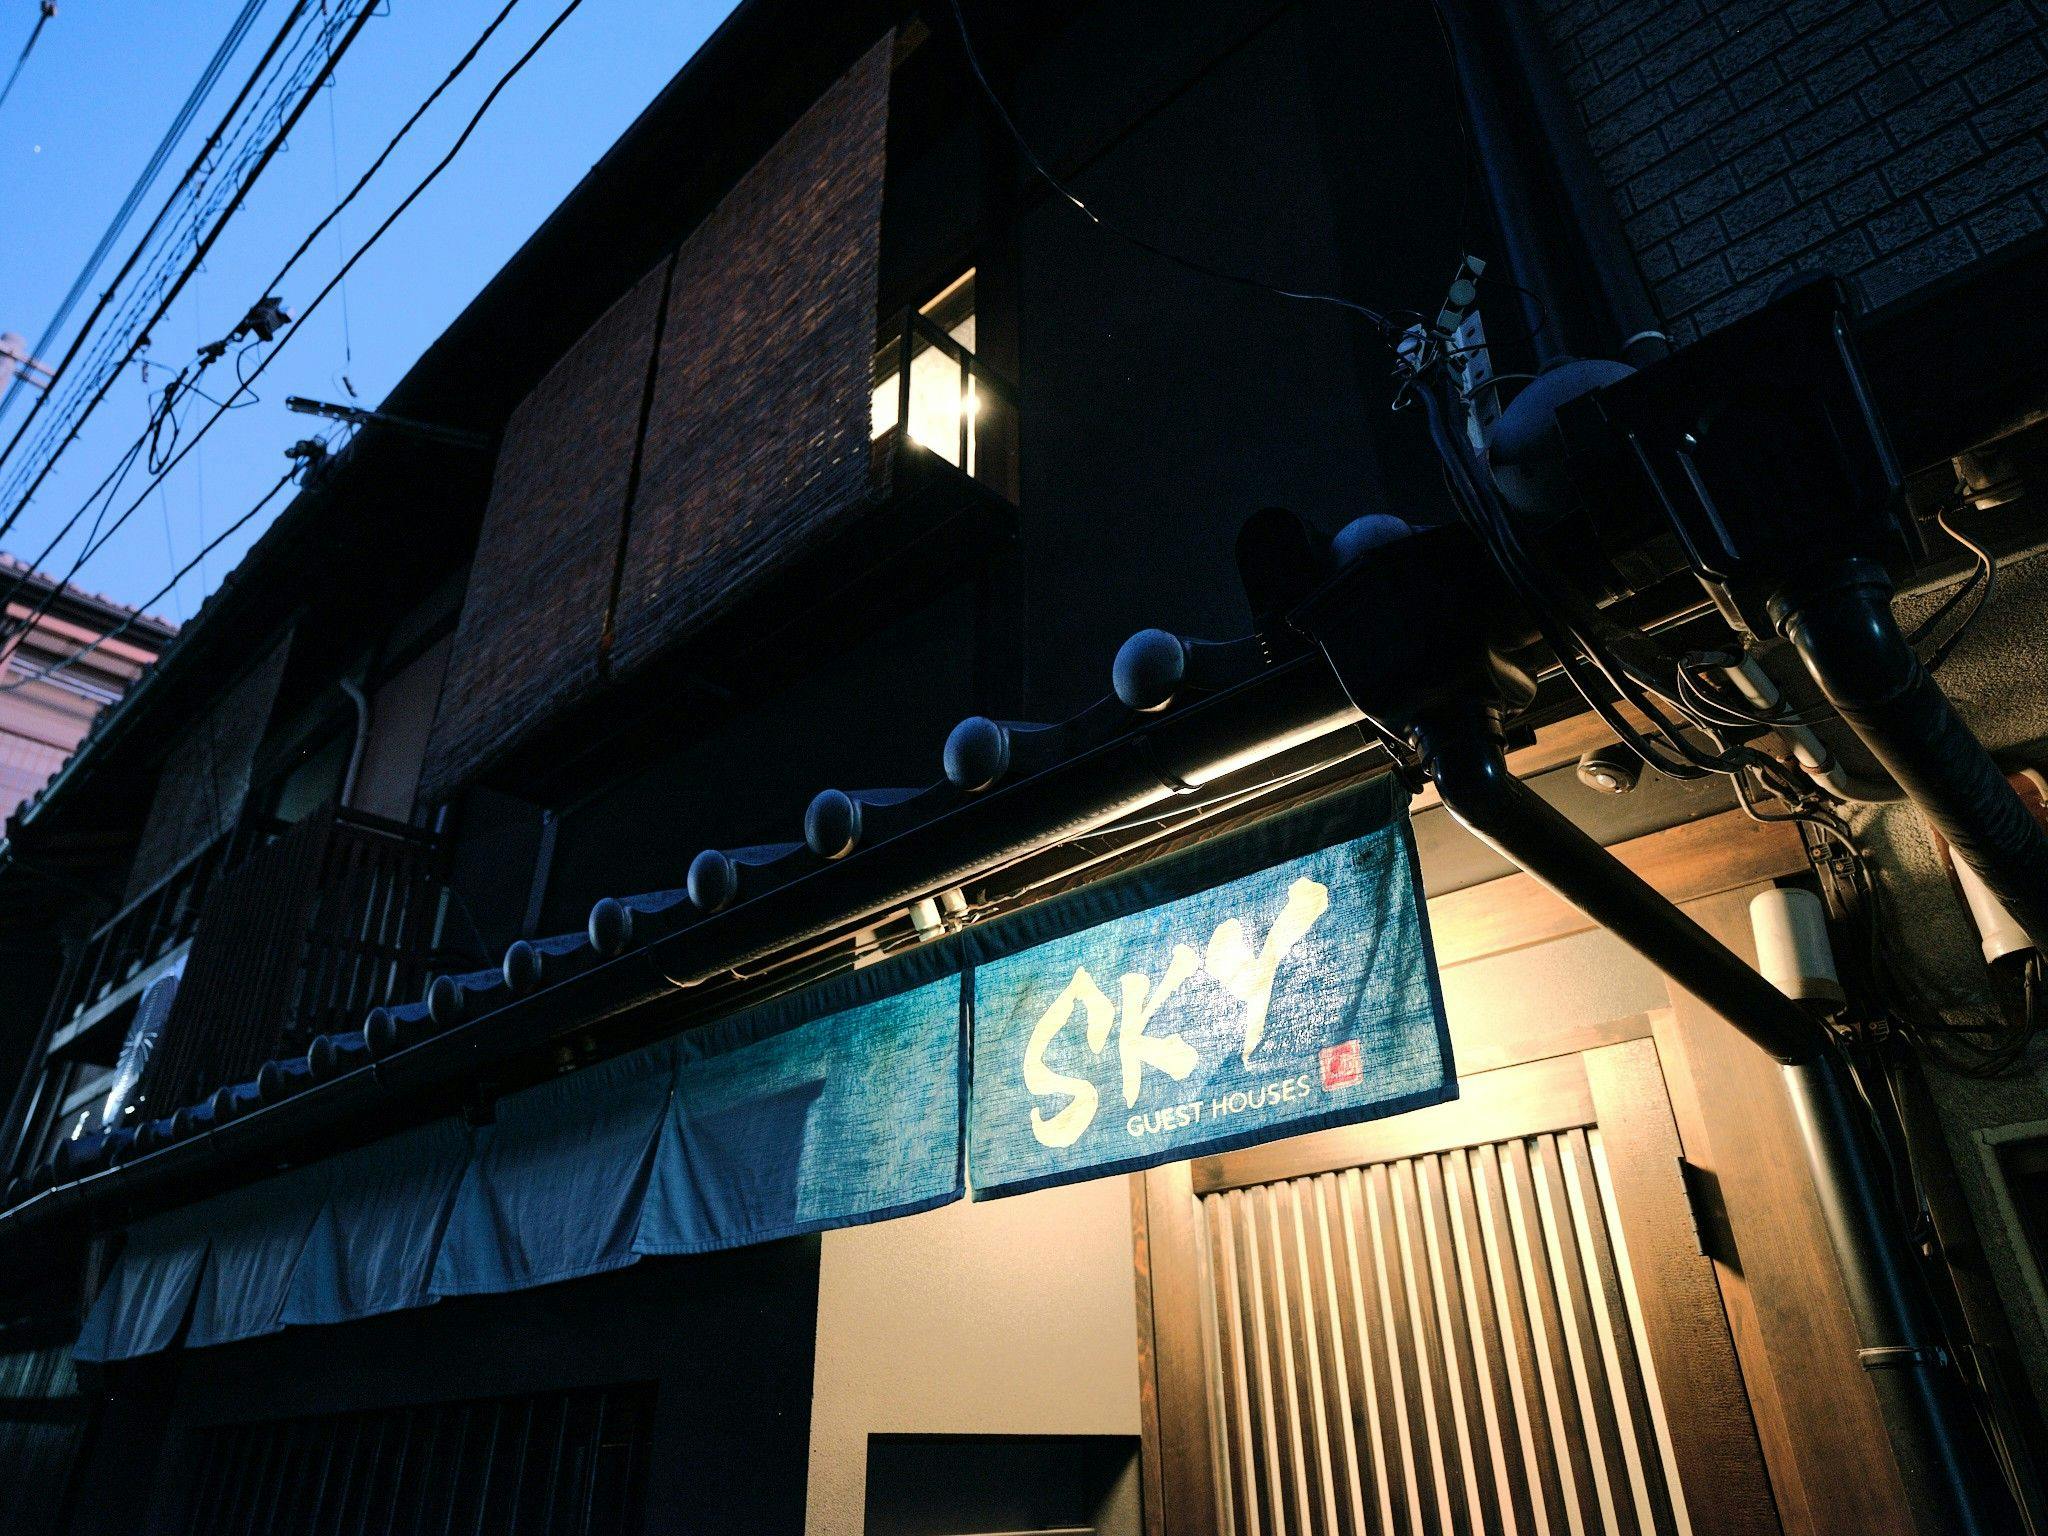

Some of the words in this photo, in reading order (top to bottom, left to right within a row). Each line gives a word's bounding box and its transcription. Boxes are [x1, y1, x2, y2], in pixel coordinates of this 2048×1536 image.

[1025, 876, 1329, 1148] SKY
[1126, 1102, 1203, 1137] GUEST
[1211, 1074, 1311, 1117] HOUSES
